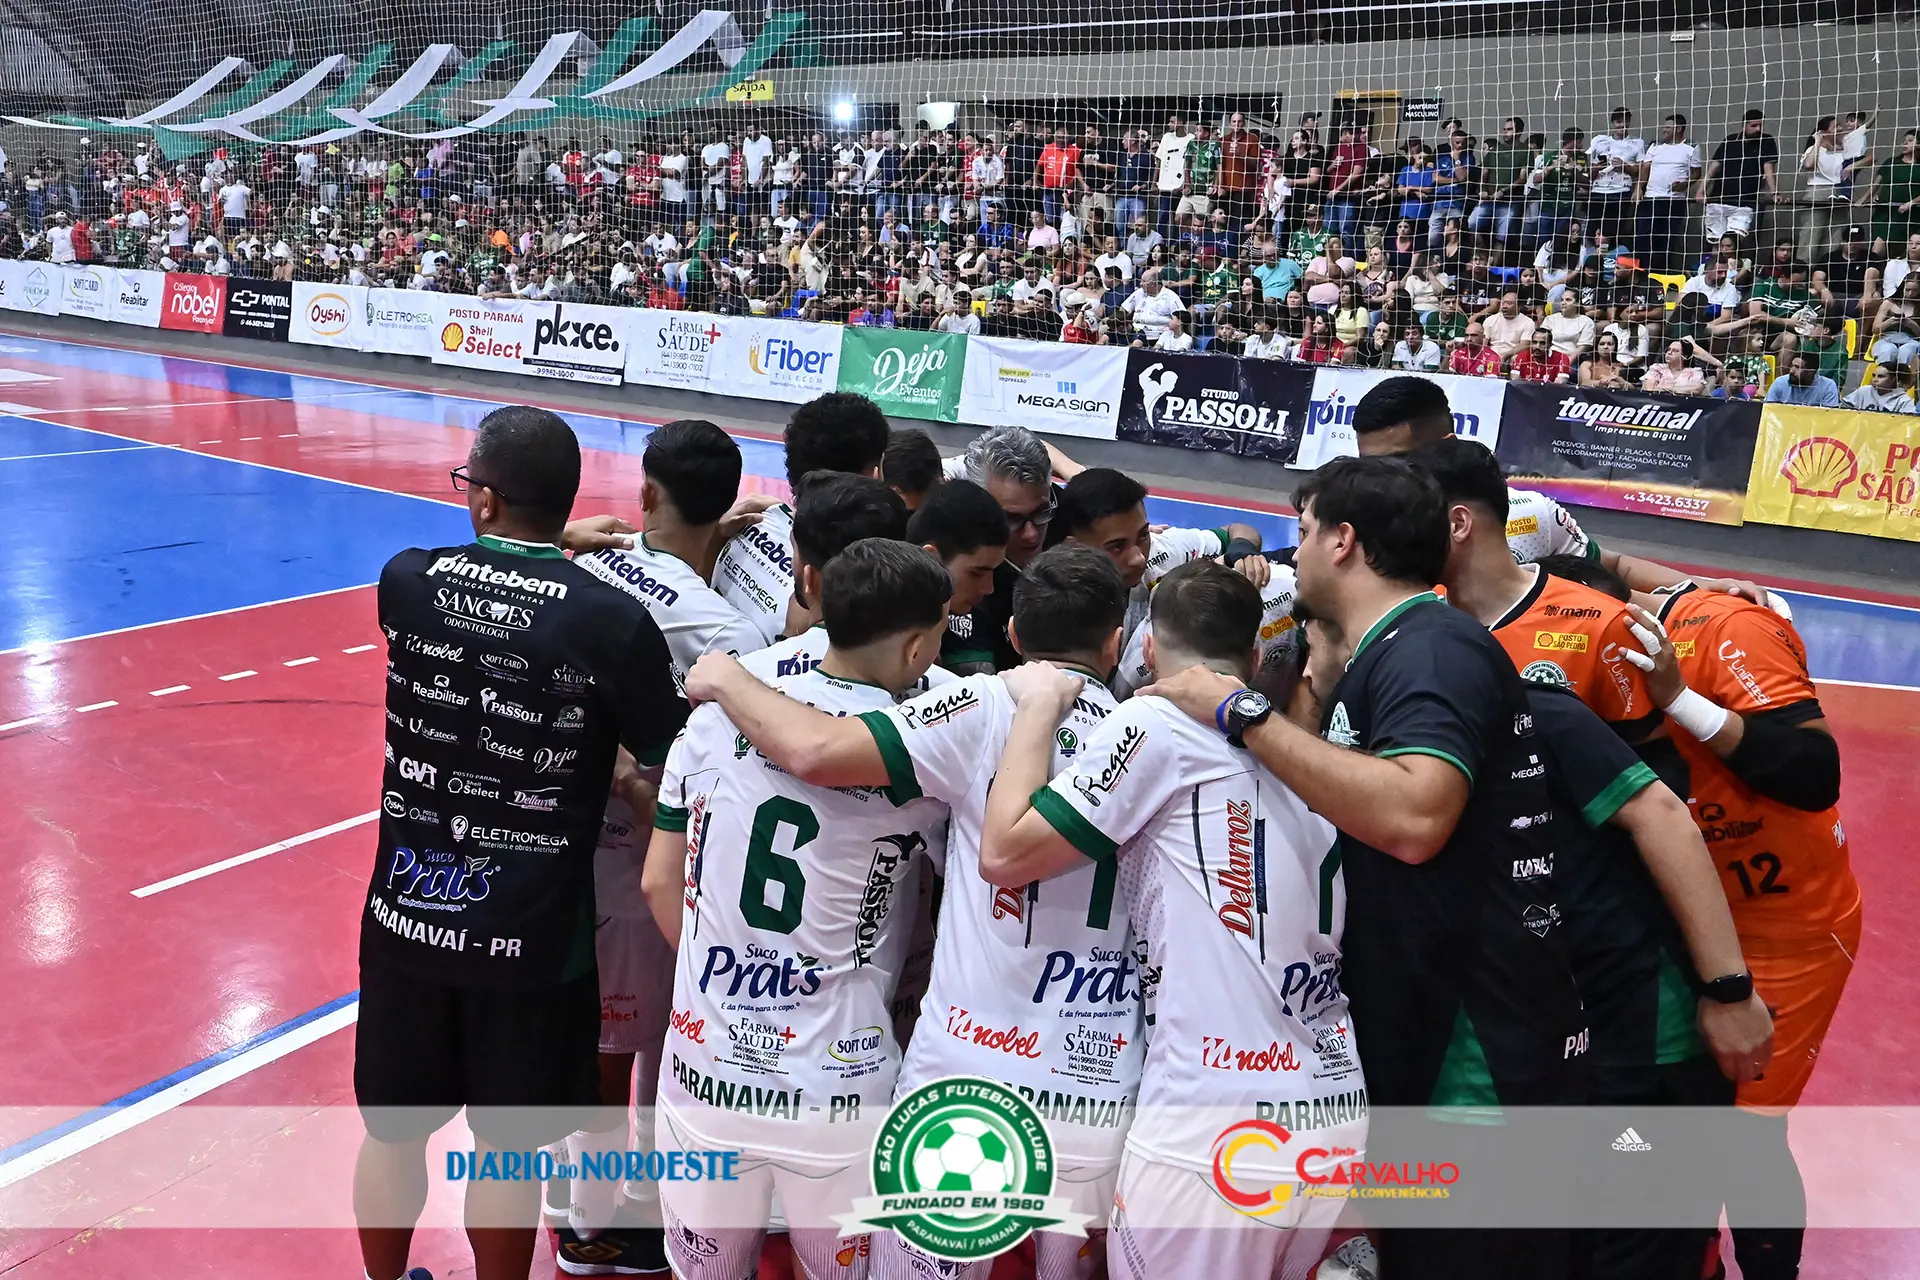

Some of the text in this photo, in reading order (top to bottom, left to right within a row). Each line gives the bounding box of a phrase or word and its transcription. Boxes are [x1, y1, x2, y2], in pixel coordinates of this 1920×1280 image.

[1405, 110, 1439, 118] MASCULINO
[171, 286, 220, 317] nobel
[261, 294, 290, 308] PONTAL
[311, 304, 346, 324] Oyshi
[376, 310, 434, 324] ELETROMEGA
[449, 308, 524, 324] POSTO PARANÁ
[469, 325, 493, 337] Shell
[669, 316, 704, 334] FARMA
[464, 335, 522, 360] Select
[657, 327, 710, 353] SAÚDE
[764, 338, 834, 374] Fiber
[872, 344, 948, 395] Deja
[899, 383, 942, 399] Eventos
[1200, 388, 1239, 401] STUDIO
[1162, 396, 1290, 435] PASSOLI
[1558, 396, 1704, 431] toquefinal
[1594, 425, 1688, 442] Impressão Digital
[1551, 439, 1693, 462] ADESIVOS BANNER PLACAS ETIQUETA
[1552, 447, 1689, 469] ENVELOPAMENTO FACHADAS EM ACM
[1598, 460, 1637, 470] LUMINOSO
[1857, 468, 1916, 505] SÃO
[1623, 491, 1710, 511] 44 3423.6337
[1509, 517, 1532, 527] POSTO
[426, 554, 569, 600] pintebem
[584, 558, 614, 584] SOLUÇÃO
[593, 548, 680, 608] ntebem
[765, 566, 789, 588] TINTAS
[445, 576, 545, 606] SOLUÇÃO EM TINTAS
[723, 554, 779, 614] ELETROMEGA
[1262, 590, 1293, 610] marin
[1560, 607, 1602, 619] marin
[444, 616, 510, 641] ODONTOLOGIA
[1558, 634, 1582, 643] POSTO
[422, 643, 464, 663] nobel
[485, 653, 522, 670] SOFT CARD
[412, 681, 470, 706] Reabilitar
[490, 701, 544, 723] PASSOLI
[897, 688, 979, 730] Roque
[478, 726, 525, 760] Roque
[533, 747, 579, 774] Deja
[1073, 726, 1146, 807] Roque
[399, 756, 438, 787] GVT
[452, 770, 474, 779] POSTO
[463, 784, 500, 800] Select
[466, 779, 482, 787] Shell
[470, 826, 569, 846] ELETROMEGA
[478, 840, 508, 850] Materiais
[514, 844, 533, 852] obras
[424, 848, 456, 863] Suco
[739, 795, 820, 936] 6
[1216, 798, 1255, 940] Dellarroz
[1727, 851, 1790, 898] 12
[489, 938, 522, 957] PR
[744, 943, 779, 961] Suco
[1088, 946, 1123, 963] Suco
[1313, 951, 1336, 968] Suco
[601, 1008, 639, 1021] elect
[737, 1003, 754, 1012] fruta
[755, 1005, 771, 1013] para
[1064, 1010, 1074, 1018] da
[1074, 1010, 1092, 1019] fruta
[1092, 1011, 1108, 1019] para
[740, 1017, 779, 1036] FARMA
[1077, 1024, 1112, 1043] FARMA
[728, 1023, 785, 1052] SAÚDE
[837, 1038, 860, 1054] SOFT
[973, 1025, 1042, 1059] nobel
[1063, 1032, 1118, 1060] SAÚDE
[1235, 1041, 1301, 1072] nobel
[672, 1052, 804, 1122] PARANAVAÍ
[828, 1093, 862, 1124] PR
[1611, 1140, 1652, 1152] adidas
